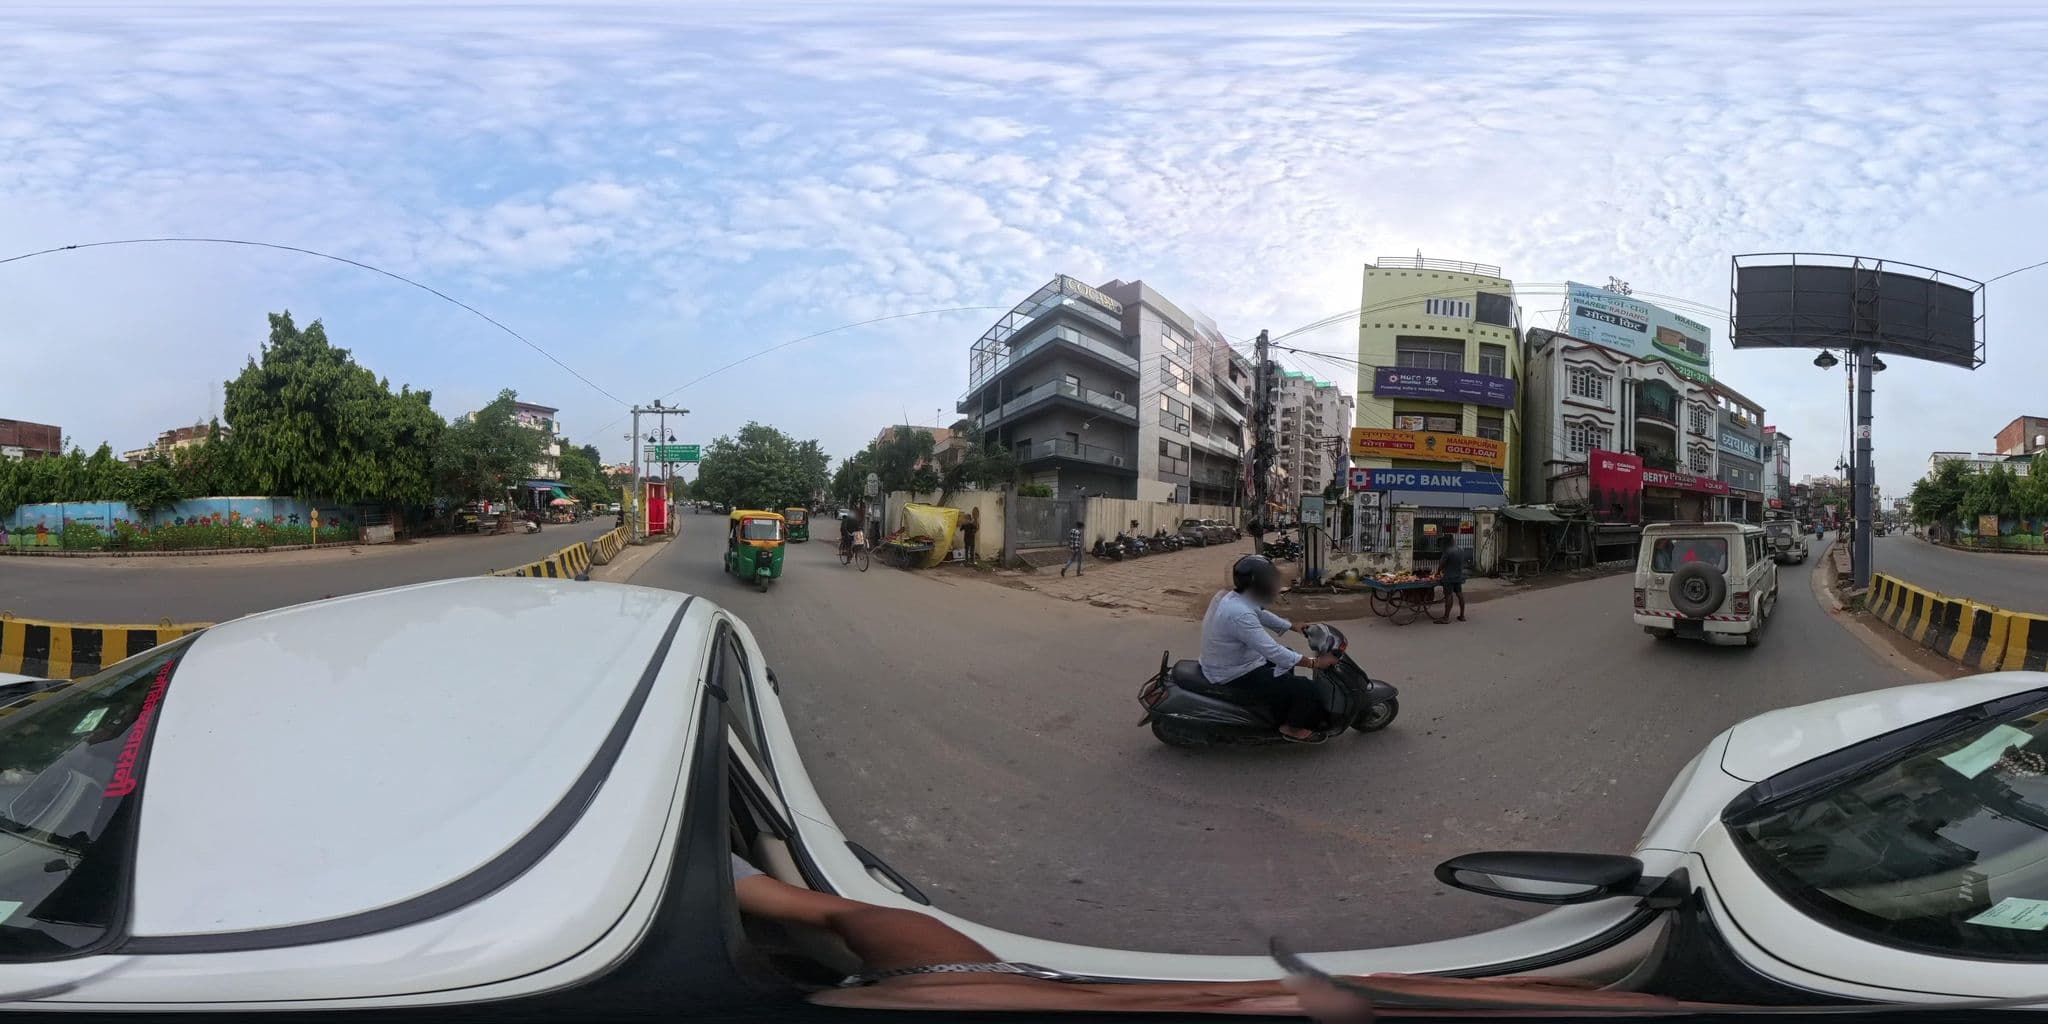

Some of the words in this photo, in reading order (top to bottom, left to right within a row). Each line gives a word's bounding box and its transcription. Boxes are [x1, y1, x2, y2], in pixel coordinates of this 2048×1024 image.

[1584, 307, 1616, 324] सोलर
[1619, 316, 1641, 331] किट
[1609, 306, 1649, 322] RADIANCE
[1447, 445, 1471, 454] GOLD
[1473, 448, 1496, 458] LOAN
[1375, 473, 1416, 486] HDFC
[1420, 474, 1463, 487] BANK
